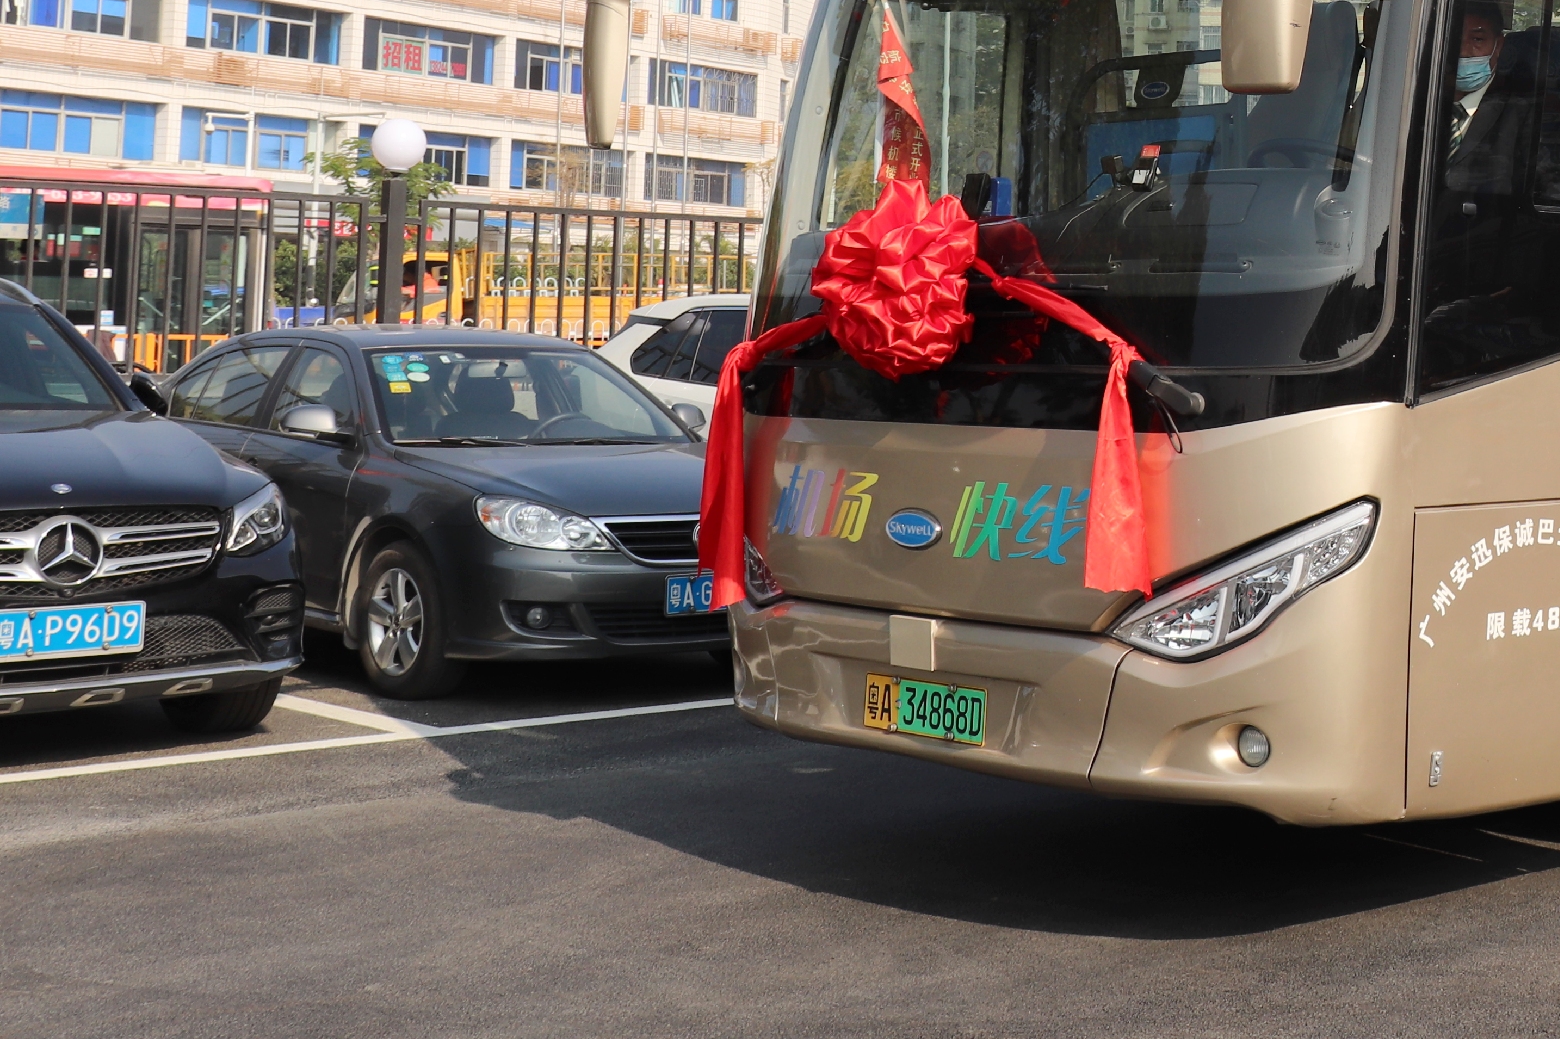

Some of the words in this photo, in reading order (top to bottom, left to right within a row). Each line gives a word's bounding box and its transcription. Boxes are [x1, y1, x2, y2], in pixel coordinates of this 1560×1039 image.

[383, 41, 422, 71] 招租
[774, 465, 880, 543] 机场
[889, 521, 932, 536] Skywell
